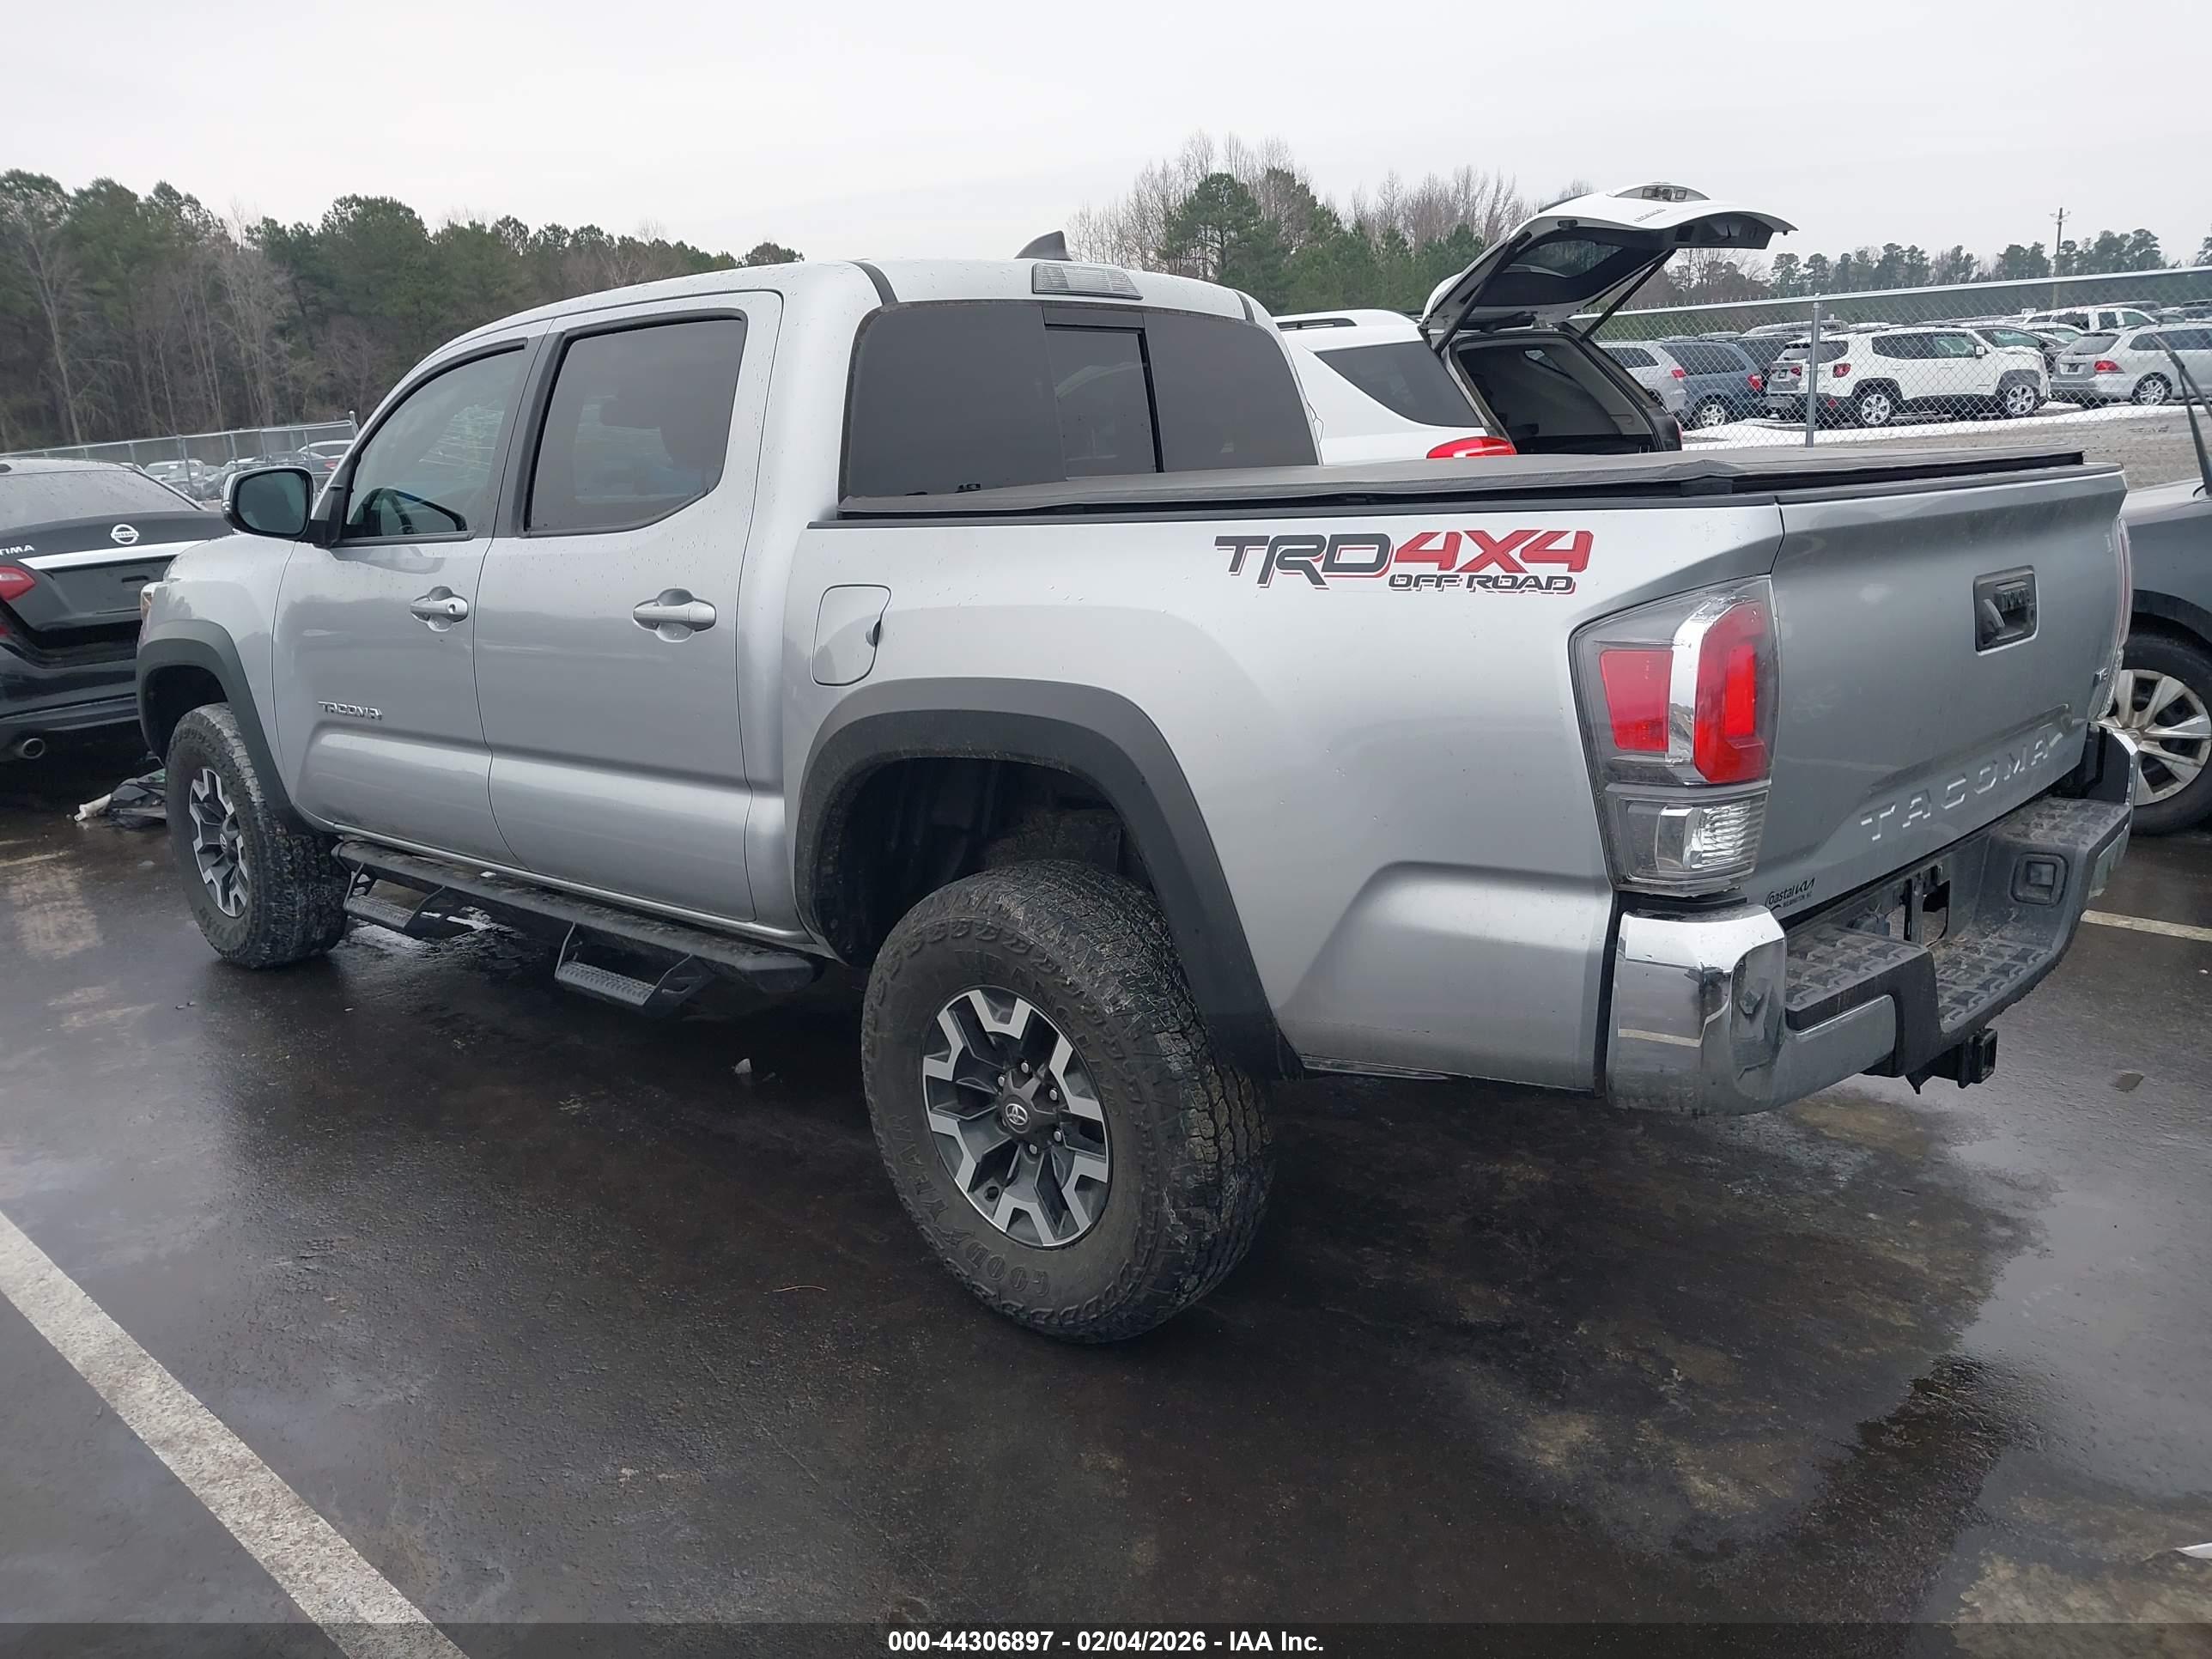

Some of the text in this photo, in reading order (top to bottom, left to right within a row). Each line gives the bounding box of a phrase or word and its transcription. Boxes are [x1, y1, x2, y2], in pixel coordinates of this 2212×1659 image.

[1214, 532, 1394, 590] TRD
[1388, 574, 1577, 595] OFF ROAD
[317, 700, 383, 720] TACOMA
[1859, 734, 2050, 842] TACOMA
[890, 1114, 1052, 1298] GOODYEAR
